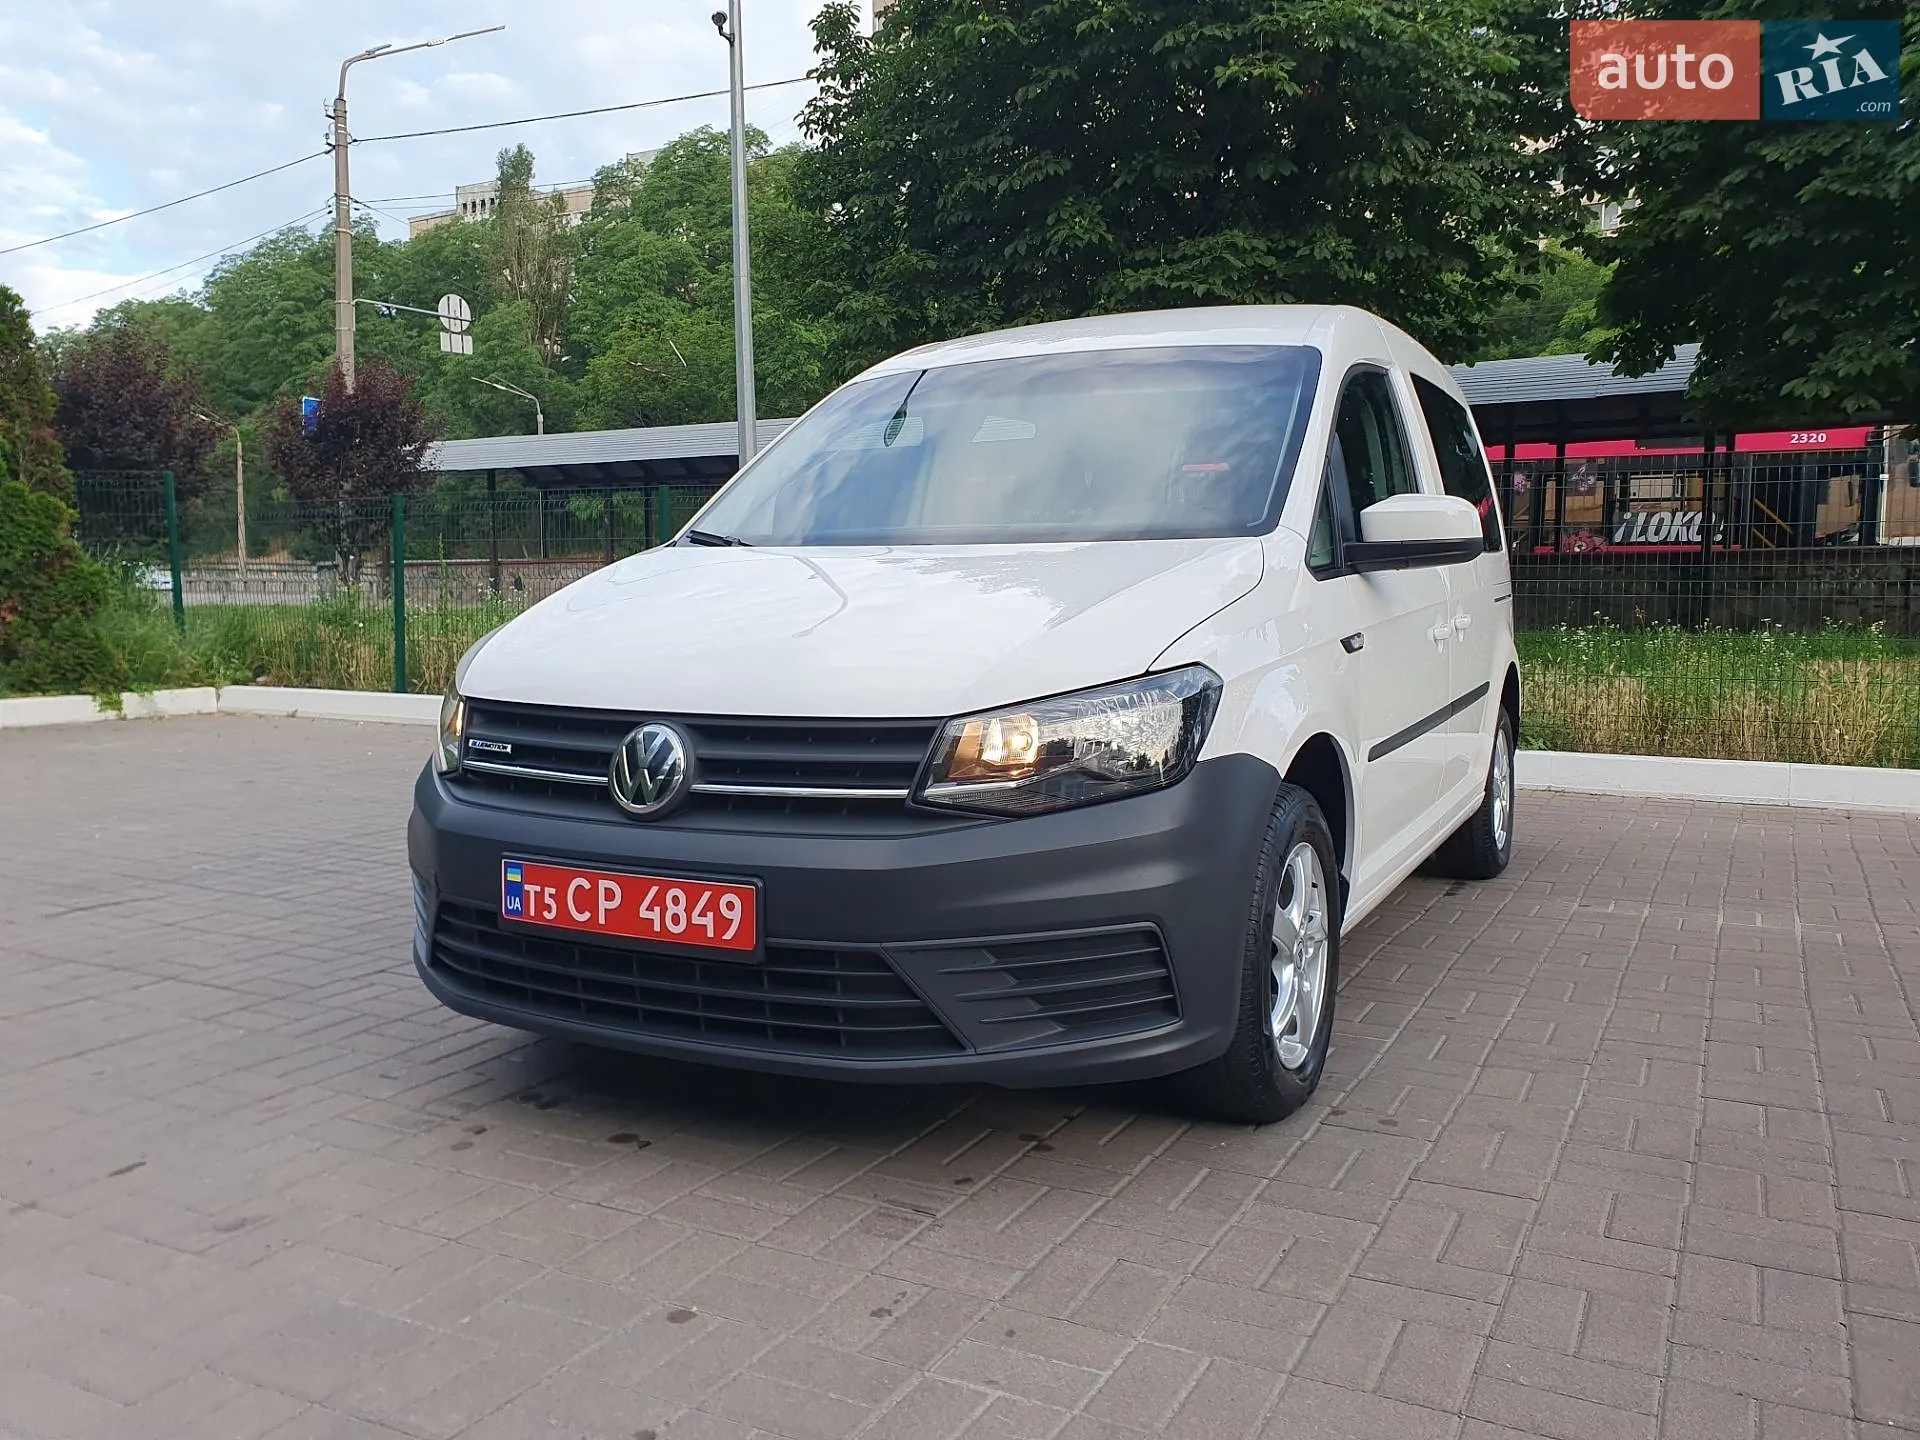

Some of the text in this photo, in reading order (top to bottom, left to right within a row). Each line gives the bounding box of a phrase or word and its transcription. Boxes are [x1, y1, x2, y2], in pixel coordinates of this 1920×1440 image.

[1790, 432, 1827, 444] 2320
[506, 895, 522, 912] UA
[524, 877, 742, 940] T5 CP 4849
